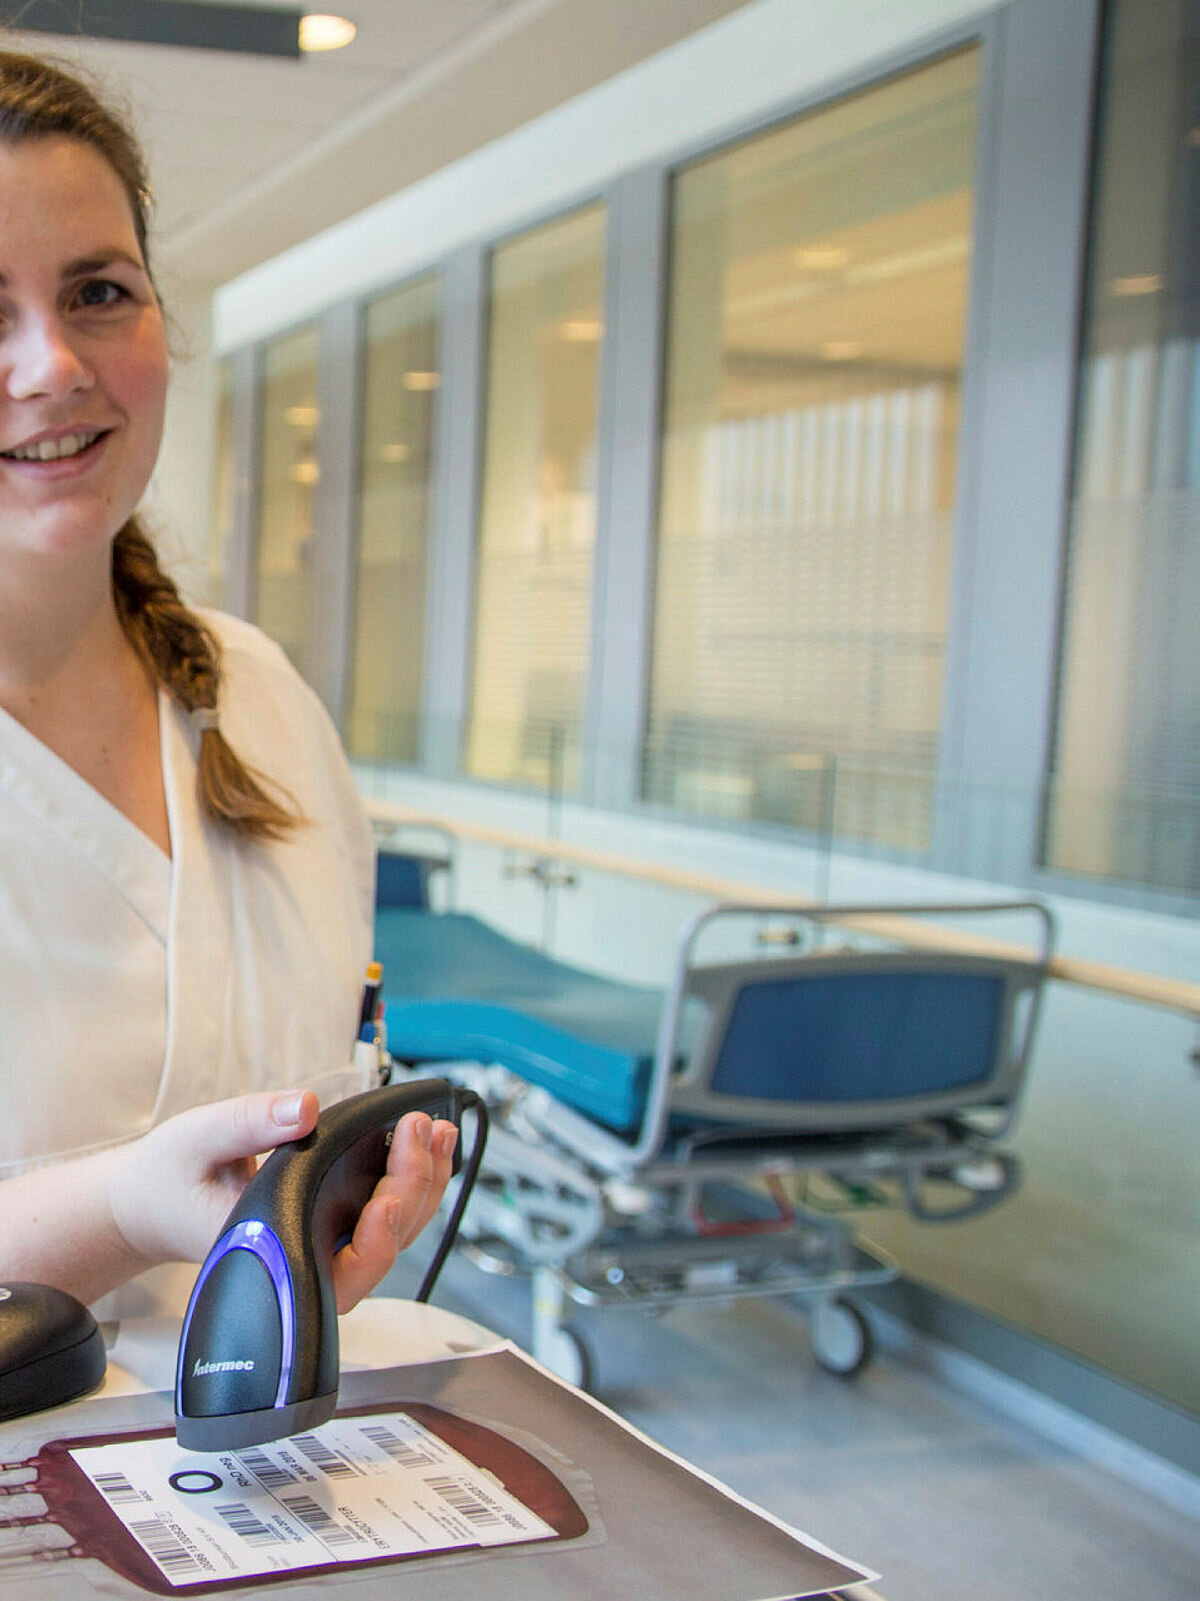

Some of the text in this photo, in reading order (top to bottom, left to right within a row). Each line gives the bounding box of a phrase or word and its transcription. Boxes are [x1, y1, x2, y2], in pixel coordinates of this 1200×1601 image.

[192, 1358, 255, 1377] Intermec
[168, 1470, 223, 1494] O
[219, 1457, 252, 1488] RhD neg
[337, 1506, 391, 1549] ERYTROCYTTER
